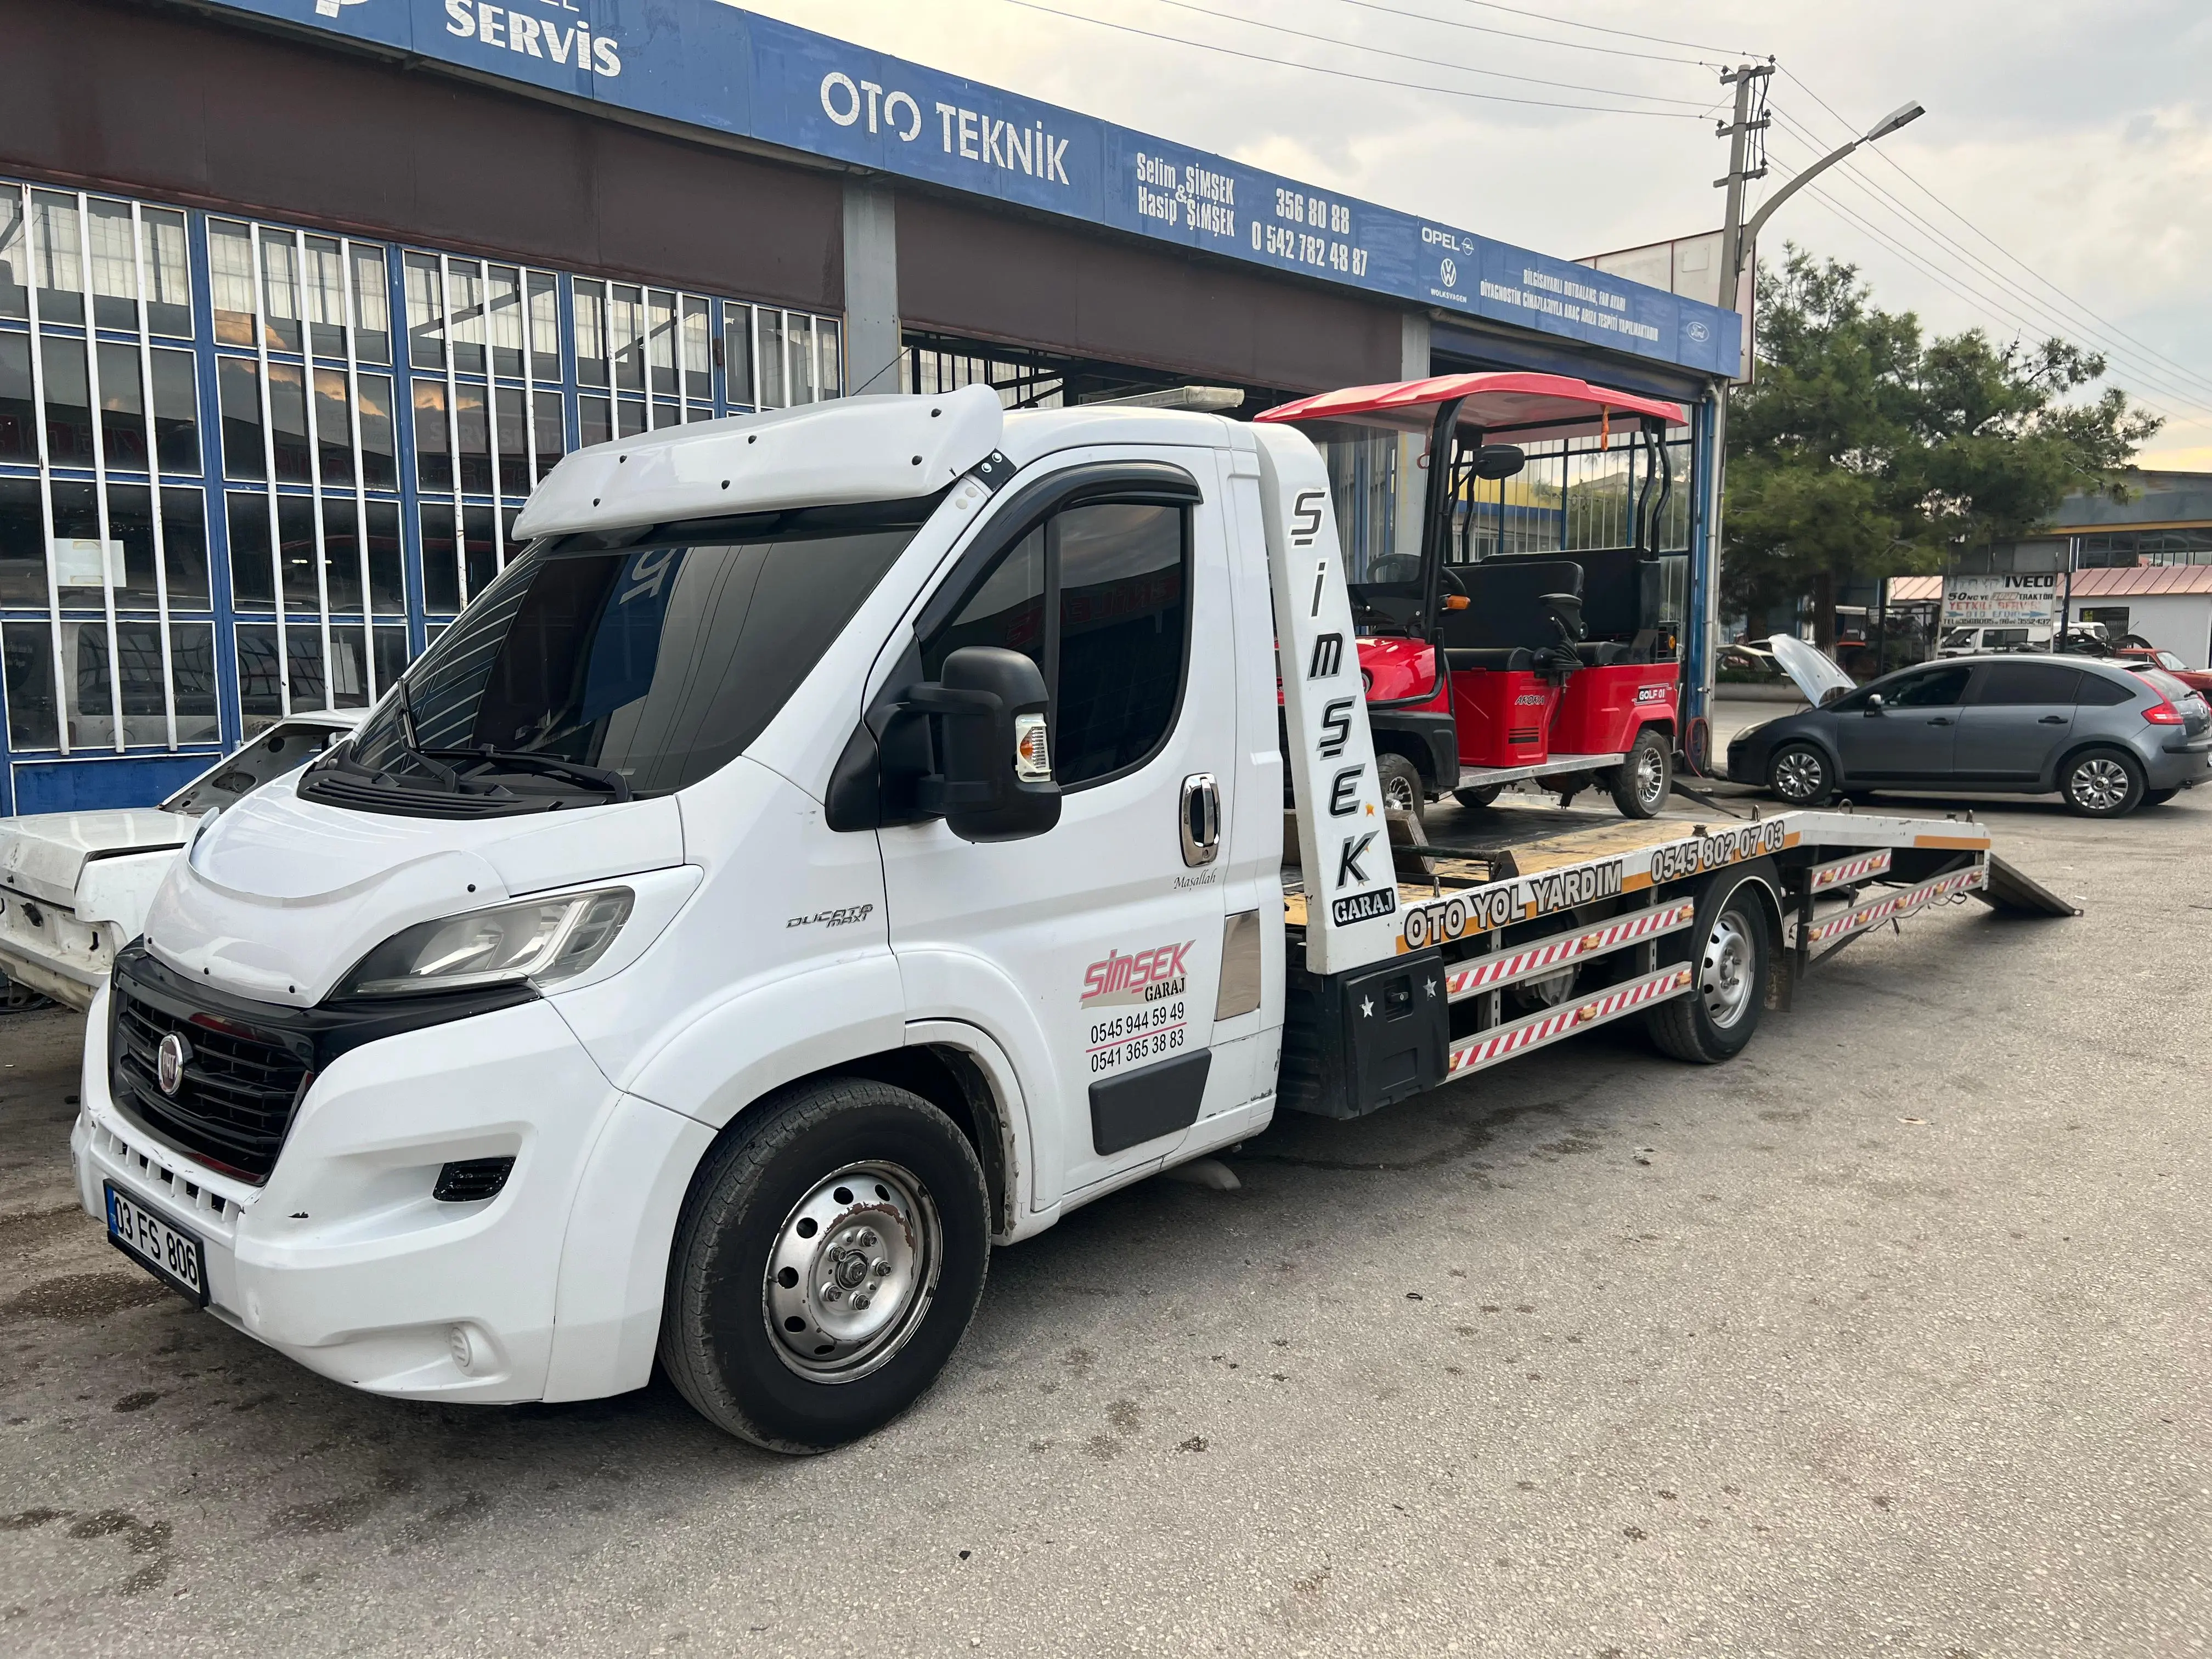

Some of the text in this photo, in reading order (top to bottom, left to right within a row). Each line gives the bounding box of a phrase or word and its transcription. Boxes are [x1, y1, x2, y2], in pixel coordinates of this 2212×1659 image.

[445, 0, 622, 77] SERVİS
[821, 72, 1070, 185] OTO TEKNİK
[1137, 153, 1234, 205] Selim ŞİMŞEK
[1175, 184, 1187, 204] &
[1138, 185, 1234, 237] Hasip ŞİMŞEK
[1276, 188, 1350, 234] 356 80 88
[1252, 221, 1368, 276] 0 542 782 48 87
[1421, 227, 1460, 251] OPEL
[1430, 288, 1467, 303] WOLKSVAGEN
[1480, 279, 1521, 306] DİYAGNOSTİK
[1564, 303, 1579, 323] ARAÇ
[1581, 308, 1596, 326] ARIZA
[1598, 313, 1617, 331] TESPİTİ
[1523, 267, 1563, 294] BİLGİSAYARLI
[1599, 291, 1610, 307] FAR
[1610, 295, 1626, 312] AYARI
[2005, 575, 2053, 588] IVECO
[1515, 695, 1544, 706] ARORA
[1639, 690, 1657, 701] GOLF
[1173, 868, 1217, 891] Maşallah
[1403, 820, 1785, 950] OTO YOL YARDIM 0545 802 07 03
[786, 904, 873, 928] DUCATO
[1333, 889, 1395, 923] GARAJ
[1145, 977, 1186, 1002] GARAJ
[1091, 1001, 1184, 1044] 0545 944 59 49
[1091, 1029, 1184, 1073] 0541 365 38 83
[114, 1196, 198, 1286] 03 FS 806
